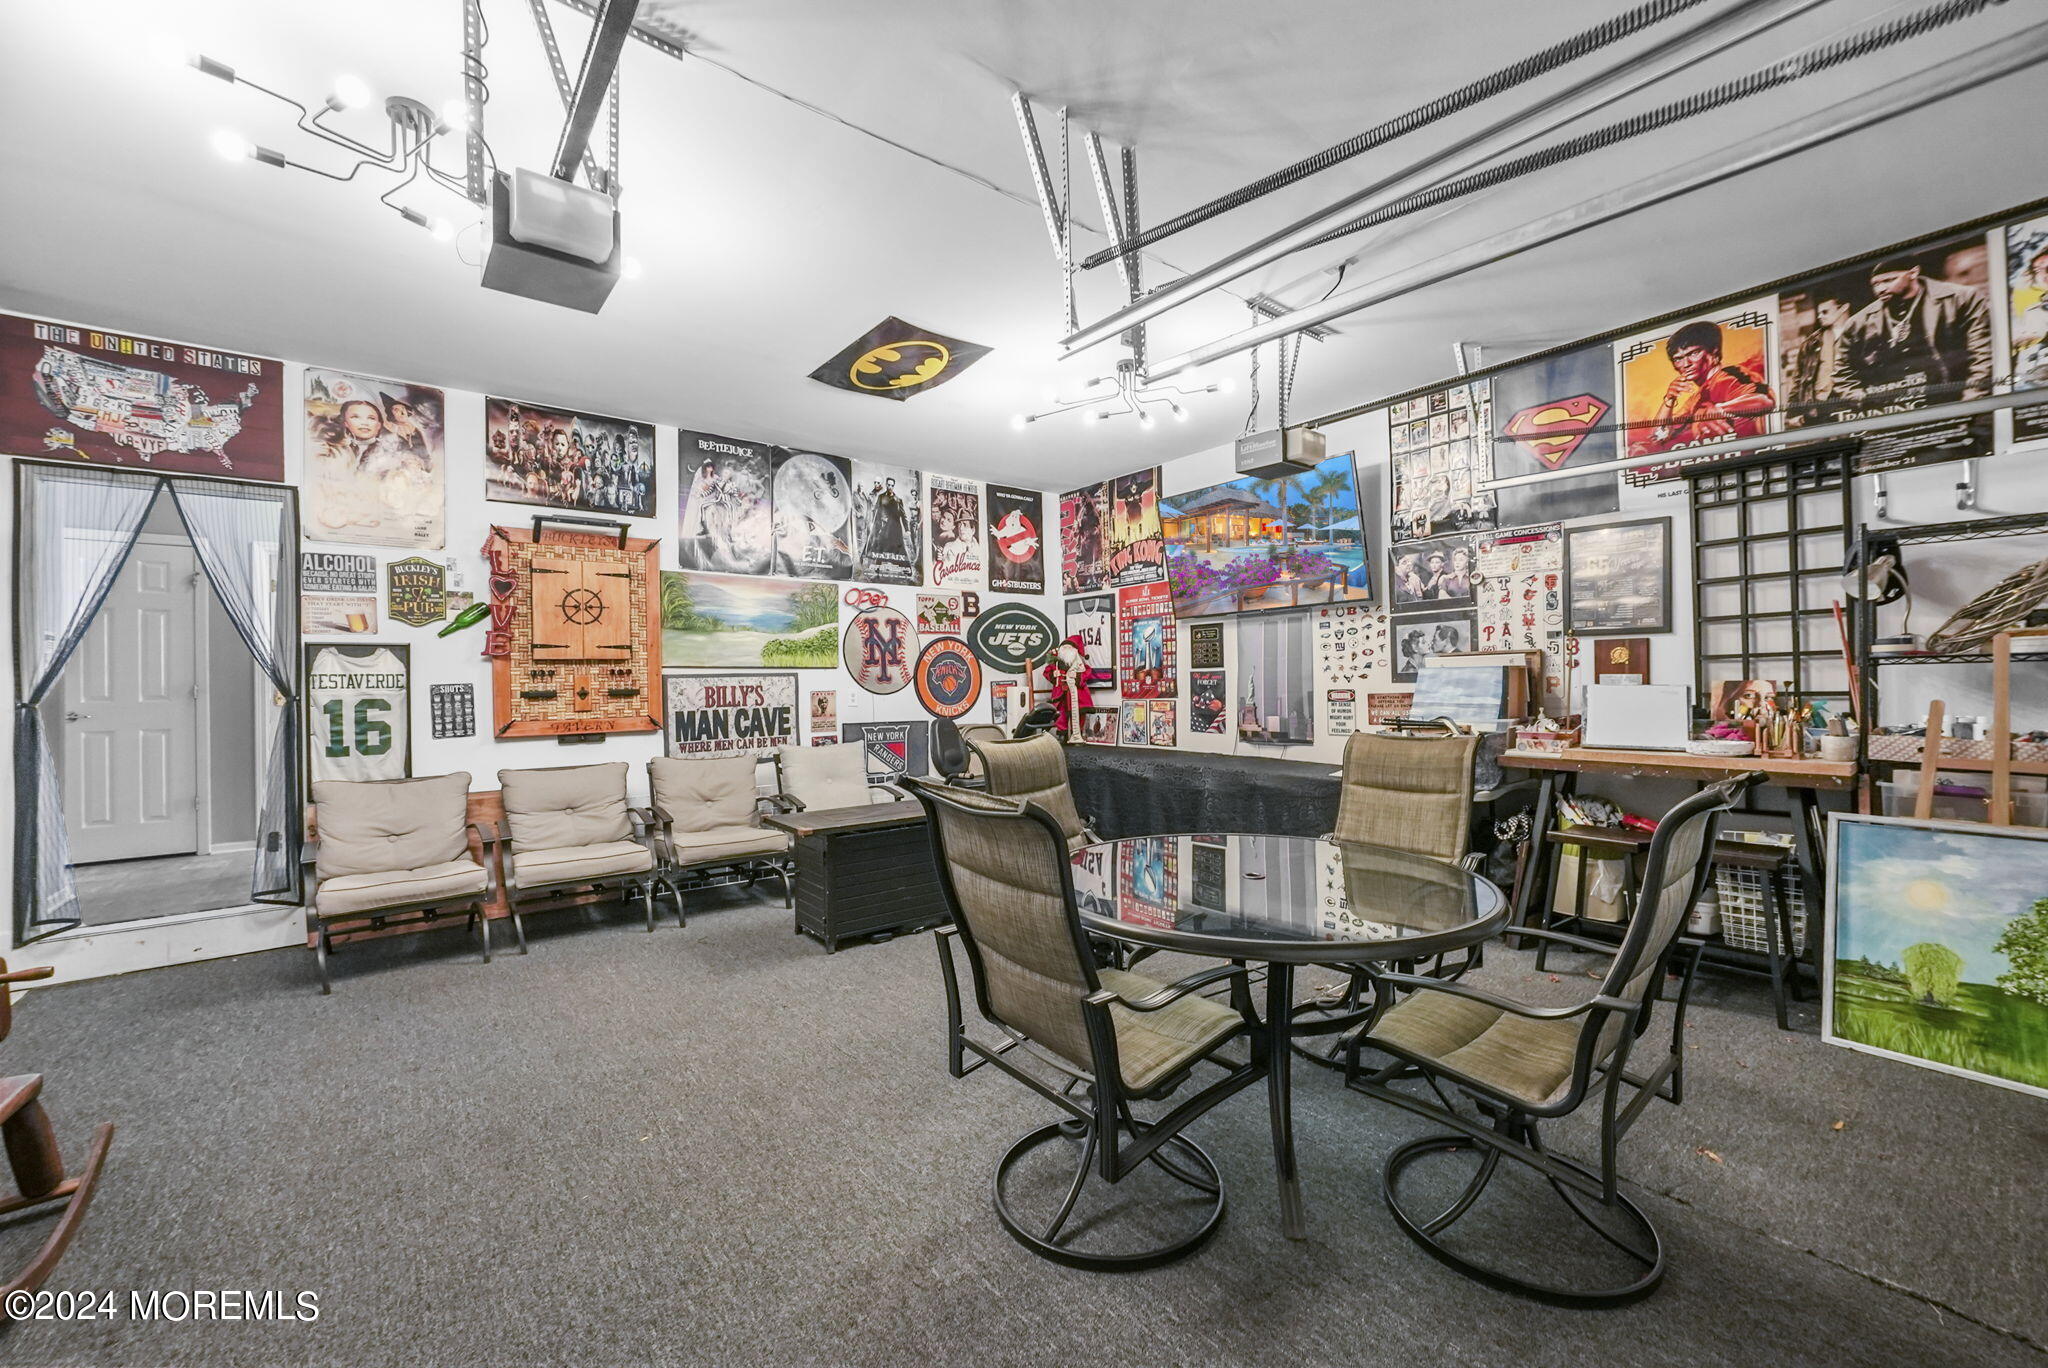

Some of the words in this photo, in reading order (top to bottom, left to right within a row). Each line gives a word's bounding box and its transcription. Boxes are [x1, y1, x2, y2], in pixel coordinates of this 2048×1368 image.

[35, 324, 79, 344] THE
[90, 332, 174, 361] UNITED
[184, 348, 261, 376] STATES
[698, 439, 753, 457] BEETLEJUICE
[1495, 531, 1512, 539] GAME
[1513, 525, 1560, 536] CONCESSIONS
[302, 553, 375, 572] ALCOHOL
[803, 546, 825, 563] E.T.
[1110, 545, 1133, 577] KING
[1133, 539, 1164, 565] KONG
[394, 564, 439, 575] BUCKLEY'S
[933, 553, 981, 586] Casablanca
[393, 574, 440, 587] IRISH
[403, 601, 435, 613] PUB
[844, 588, 889, 608] Open
[961, 591, 980, 618] B
[919, 624, 960, 632] BASEBALL
[1079, 627, 1102, 646] USA
[988, 632, 1044, 647] JETS
[923, 642, 946, 664] NEW
[948, 639, 974, 662] YORK
[933, 664, 965, 679] KNICKS
[310, 673, 405, 690] TESTAVERDE
[439, 685, 465, 694] SHOTS
[704, 685, 766, 708] BILLY'S
[935, 700, 971, 717] KNICKS
[323, 698, 392, 757] 16
[675, 709, 729, 743] MAN
[734, 706, 792, 739] CAVE
[679, 741, 711, 754] WHERE
[714, 737, 734, 751] MEN
[736, 738, 755, 749] CAN
[756, 738, 768, 748] BE
[770, 735, 788, 747] MEN
[867, 731, 884, 741] NEW
[885, 730, 905, 740] YORK
[873, 744, 904, 770] RANGERS
